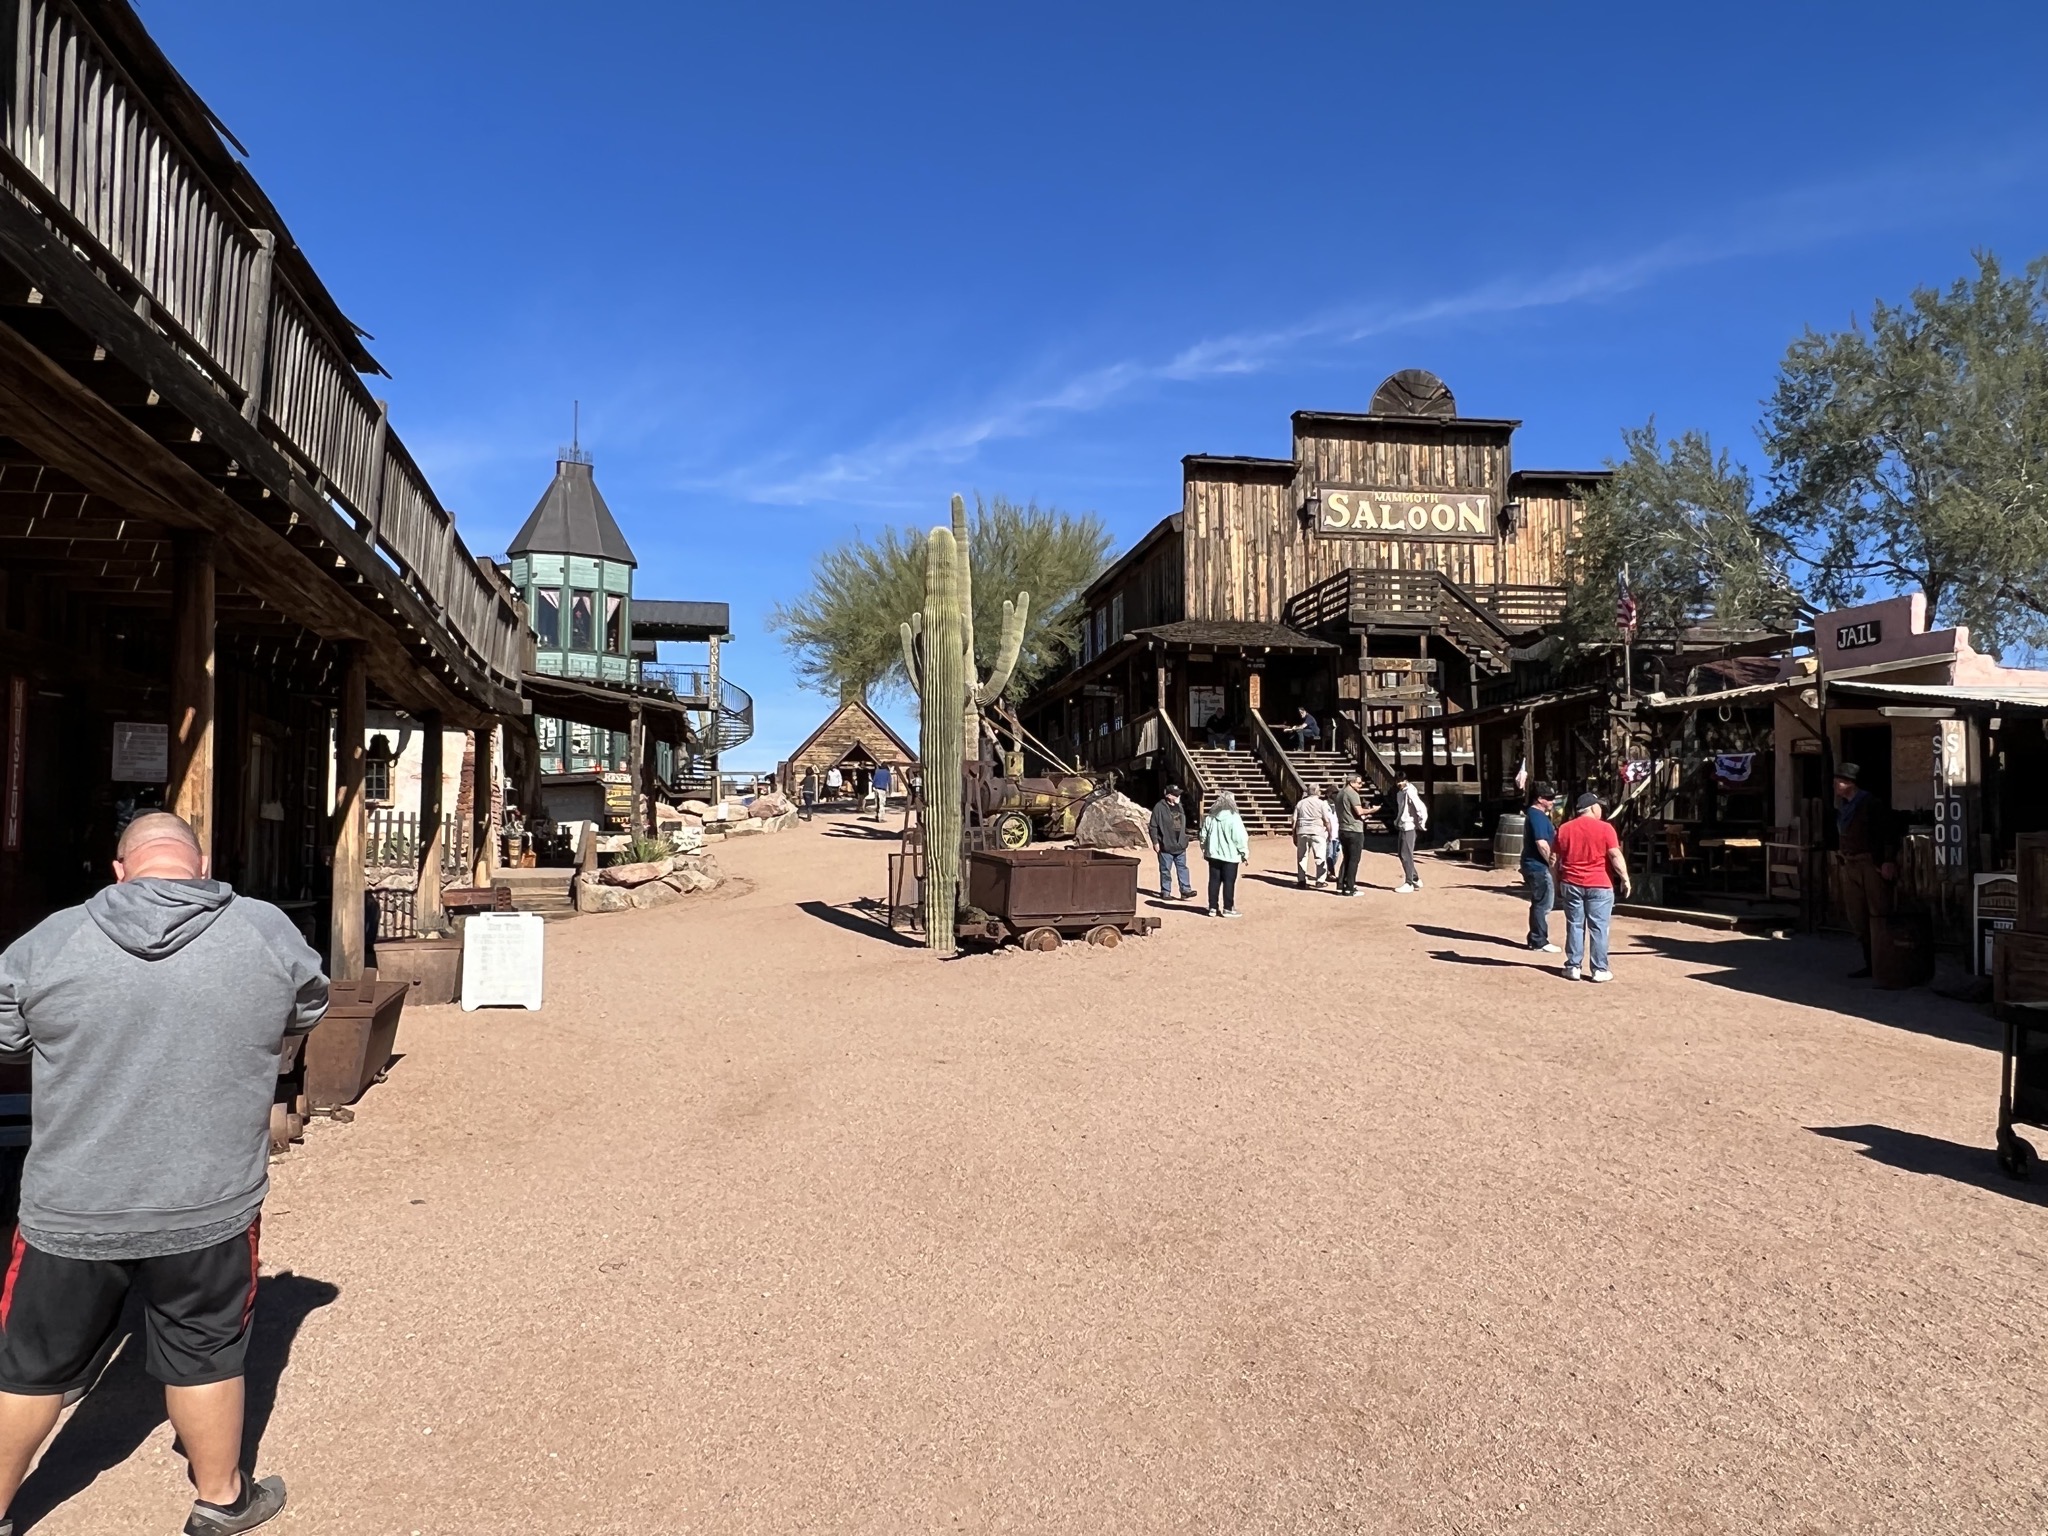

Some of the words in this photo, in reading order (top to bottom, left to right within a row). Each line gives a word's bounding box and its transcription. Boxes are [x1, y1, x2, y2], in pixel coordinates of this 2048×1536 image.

[1323, 492, 1487, 534] SALOON
[1374, 492, 1439, 503] MAMMOTH
[1838, 623, 1876, 648] JAIL
[710, 637, 719, 708] BORDELLO
[1932, 735, 1946, 866] SALOON
[1946, 733, 1963, 866] SALOON
